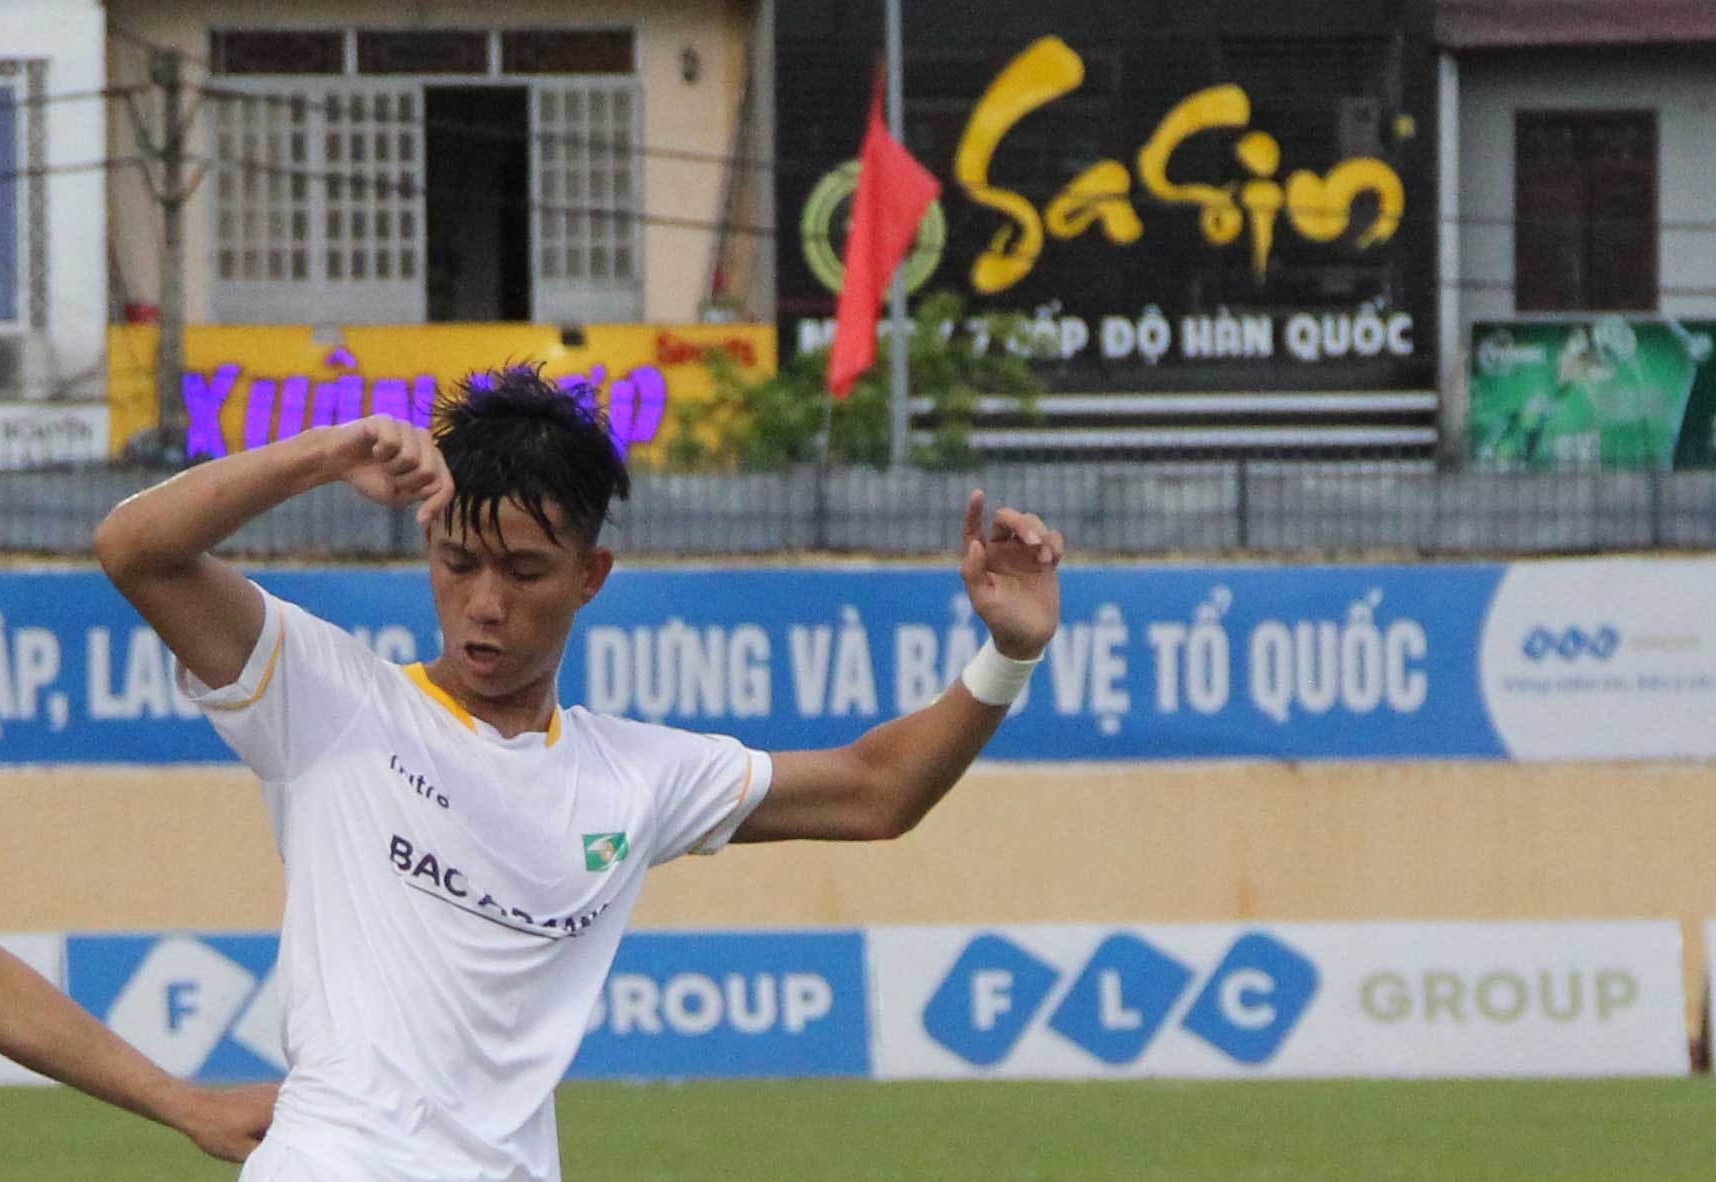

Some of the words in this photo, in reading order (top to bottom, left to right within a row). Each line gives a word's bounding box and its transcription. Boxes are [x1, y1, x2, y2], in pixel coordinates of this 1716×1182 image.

[1182, 303, 1275, 358] HÀN
[1283, 294, 1415, 362] QUỐC
[86, 626, 202, 719] LA
[788, 603, 880, 718] VÀ
[1049, 602, 1132, 736] VỆ
[1148, 585, 1233, 713] TỔ
[1249, 587, 1429, 724] QUỐC
[389, 834, 468, 898] BAC
[970, 967, 1282, 1032] FLC
[1357, 969, 1642, 1027] GROUP
